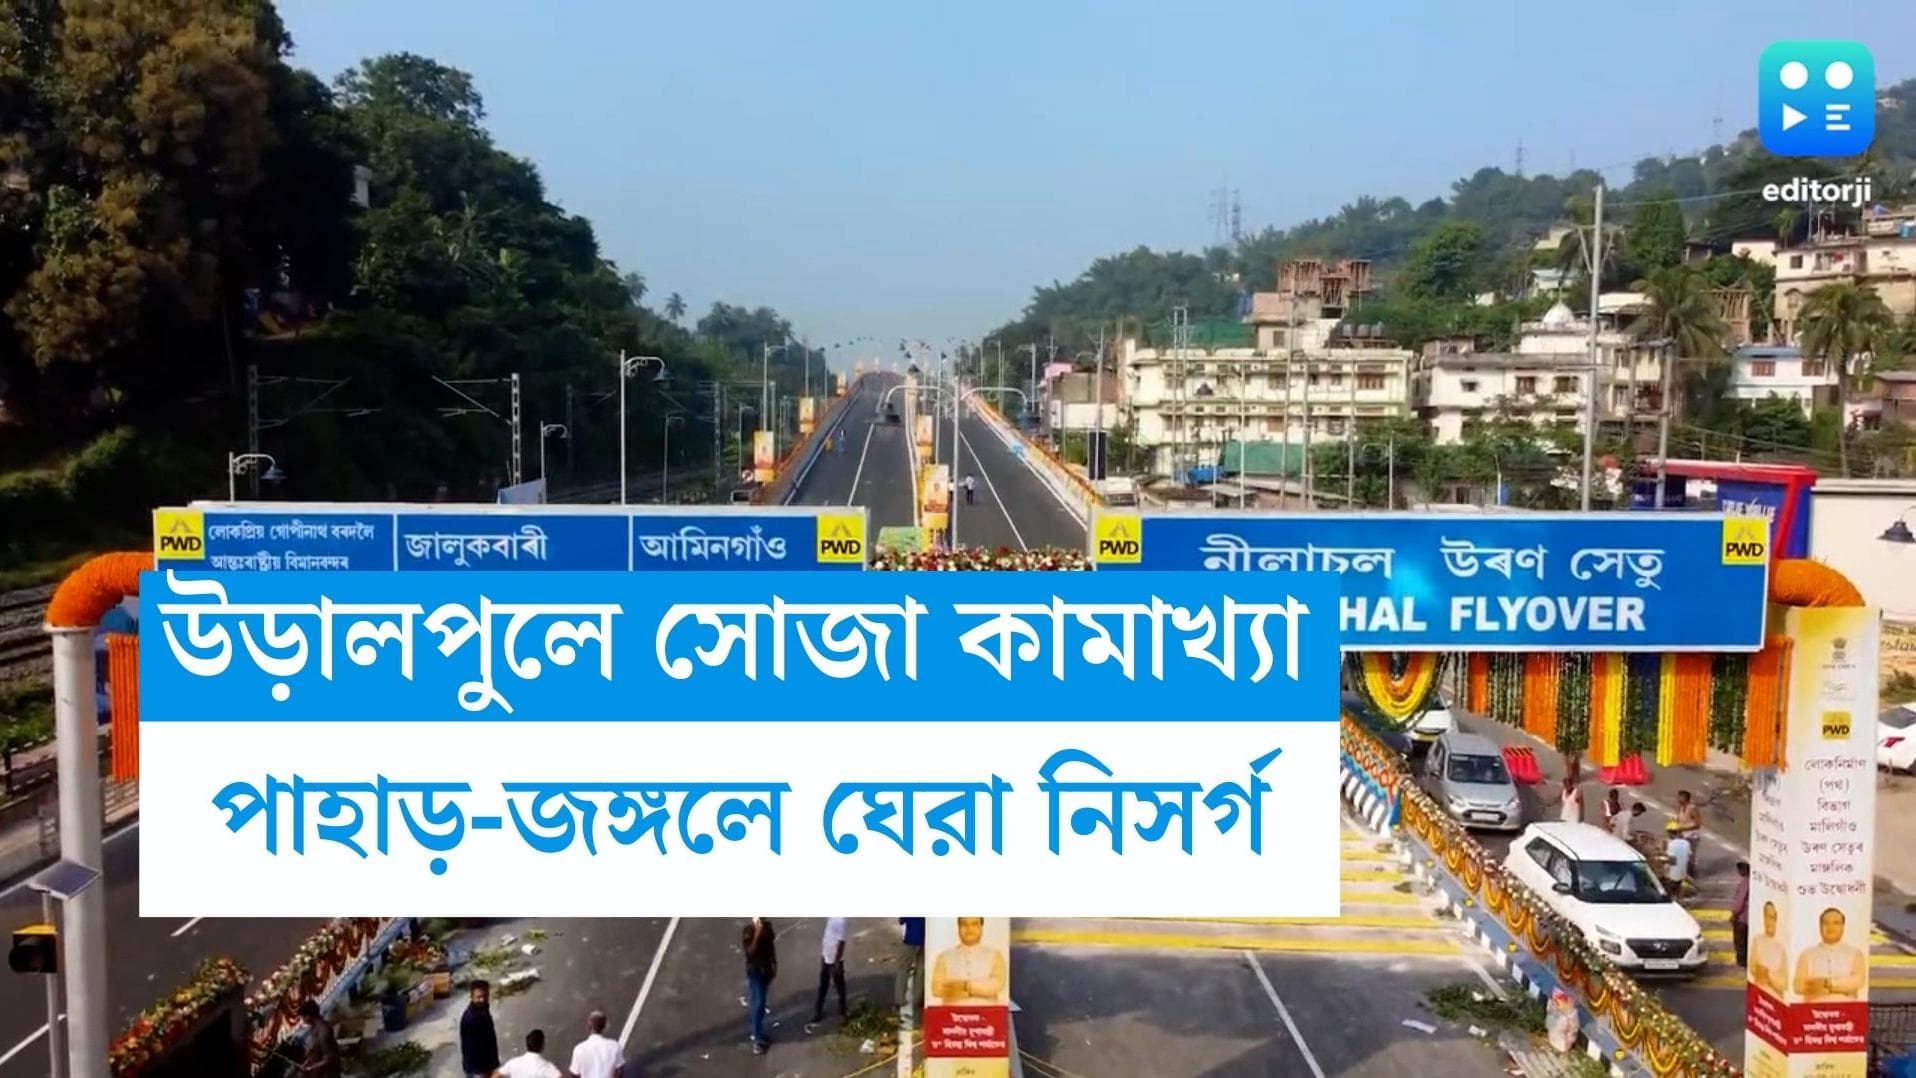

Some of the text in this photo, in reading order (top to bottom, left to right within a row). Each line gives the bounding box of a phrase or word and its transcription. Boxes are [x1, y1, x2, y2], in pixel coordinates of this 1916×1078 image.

[270, 519, 328, 540] গোপীনাথ
[160, 536, 202, 551] PWD
[403, 524, 548, 567] জালুকবাৰী
[639, 525, 787, 562] আমিনগাঁও
[820, 539, 861, 555] PWD
[1099, 539, 1139, 555] PWD
[1725, 542, 1764, 557] PWD
[1440, 536, 1548, 580] উৰণ
[1570, 548, 1665, 590] সেতু
[1450, 596, 1646, 632] FLYOVER
[1822, 725, 1850, 736] PWD
